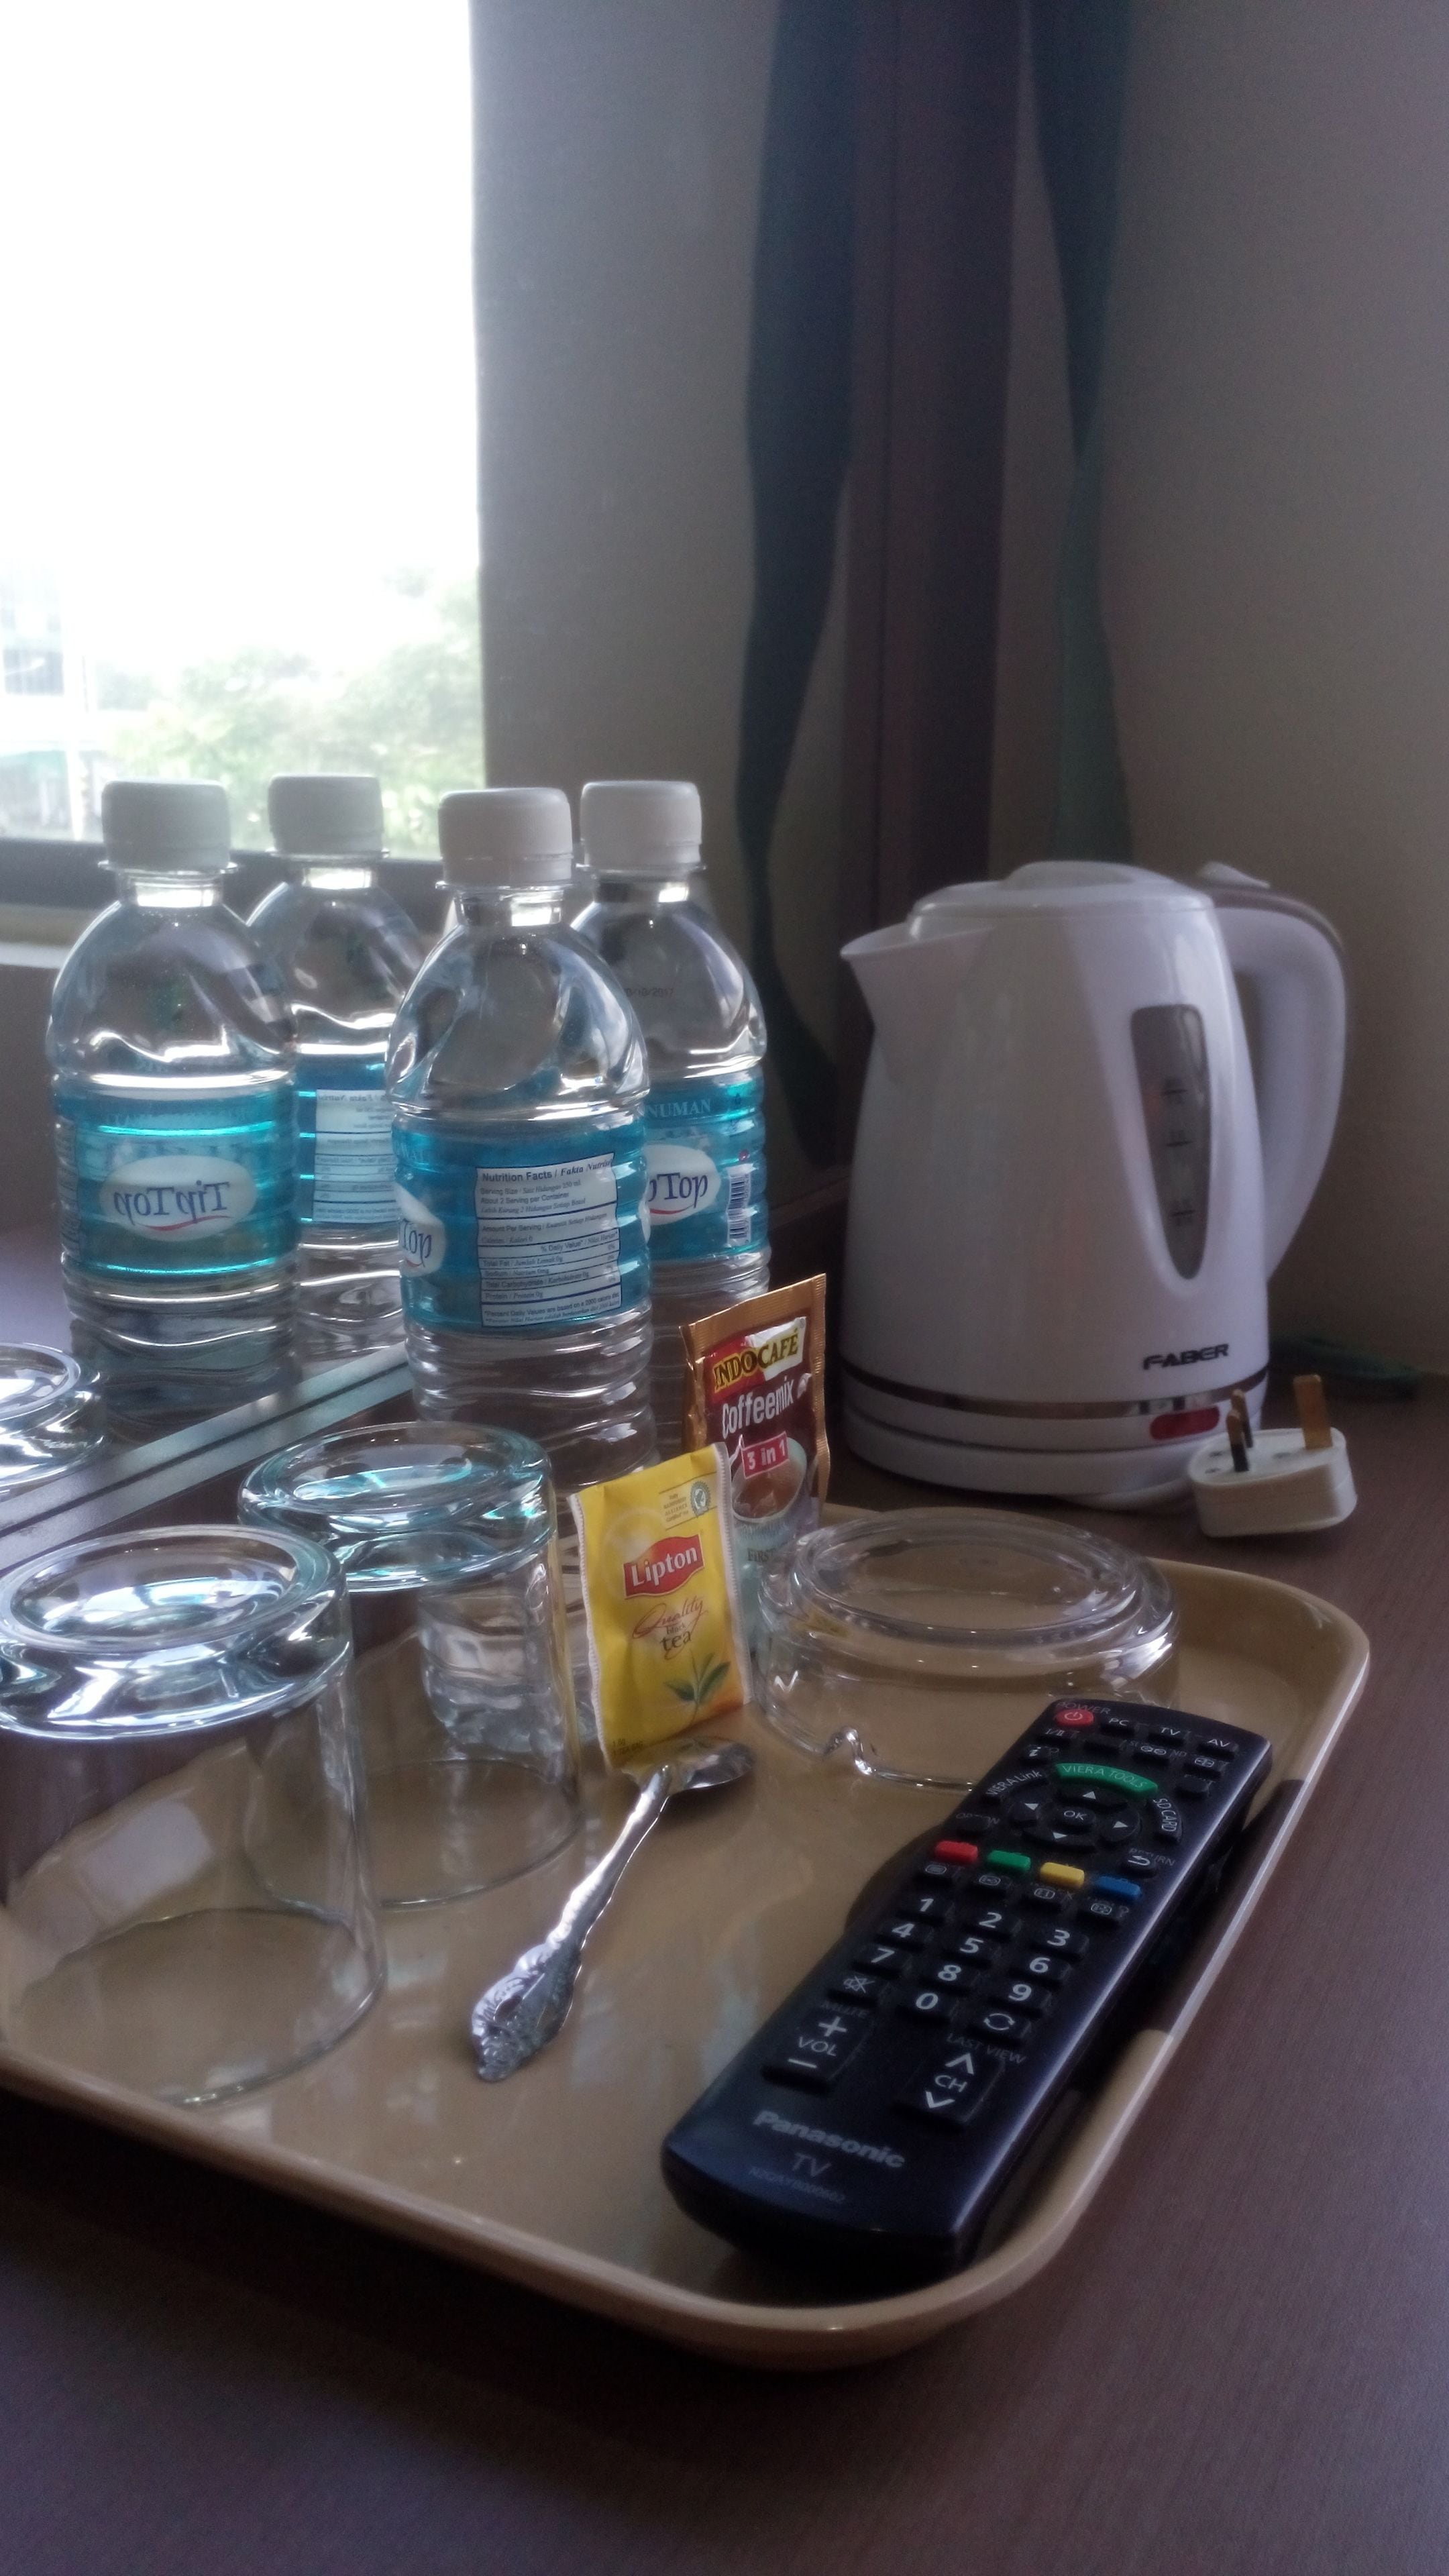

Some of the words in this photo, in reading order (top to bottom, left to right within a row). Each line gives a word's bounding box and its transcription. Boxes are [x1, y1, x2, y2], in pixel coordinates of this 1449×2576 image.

[648, 1099, 711, 1118] NUMAN
[483, 1173, 523, 1182] Nutrition
[527, 1170, 552, 1181] Facts
[561, 1167, 584, 1177] Fakta
[506, 1197, 529, 1205] Serving
[530, 1195, 540, 1203] per
[542, 1192, 569, 1201] Container
[519, 1224, 541, 1232] Serving
[549, 1244, 564, 1252] Daily
[1143, 1344, 1229, 1370] FABER
[722, 1376, 794, 1440] Coffeemix
[747, 1452, 756, 1470] 3
[761, 1448, 775, 1465] in
[780, 1439, 786, 1456] 1
[631, 1547, 697, 1587] Lipton
[633, 1596, 708, 1639] Quality
[660, 1631, 692, 1652] tea
[1057, 1701, 1112, 1714] POWER
[1108, 1717, 1130, 1726] PC
[1161, 1727, 1181, 1735] TV
[1208, 1739, 1230, 1748] AV
[986, 1776, 1016, 1797] VIERA
[1014, 1770, 1042, 1784] Link
[1062, 1765, 1105, 1776] VIERA
[1110, 1770, 1148, 1788] TOOLS
[1152, 1798, 1172, 1809] SD
[1063, 1811, 1088, 1821] OK
[1161, 1810, 1177, 1831] CARD
[920, 1898, 934, 1912] 1
[979, 1912, 1002, 1929] 2
[892, 1923, 915, 1937] 4
[1047, 1929, 1071, 1946] 3
[960, 1937, 984, 1953] 5
[871, 1948, 895, 1963] 7
[938, 1965, 962, 1981] 8
[1029, 1957, 1051, 1973] 6
[916, 1992, 938, 2010] 0
[1008, 1984, 1032, 2001] 9
[820, 2000, 868, 2018] MUTE
[798, 2036, 837, 2057] VOL
[947, 2033, 983, 2049] LAST
[987, 2045, 1027, 2063] VIEW
[934, 2075, 967, 2092] CH
[752, 2110, 905, 2168] Panasonic
[792, 2151, 832, 2178] TV
